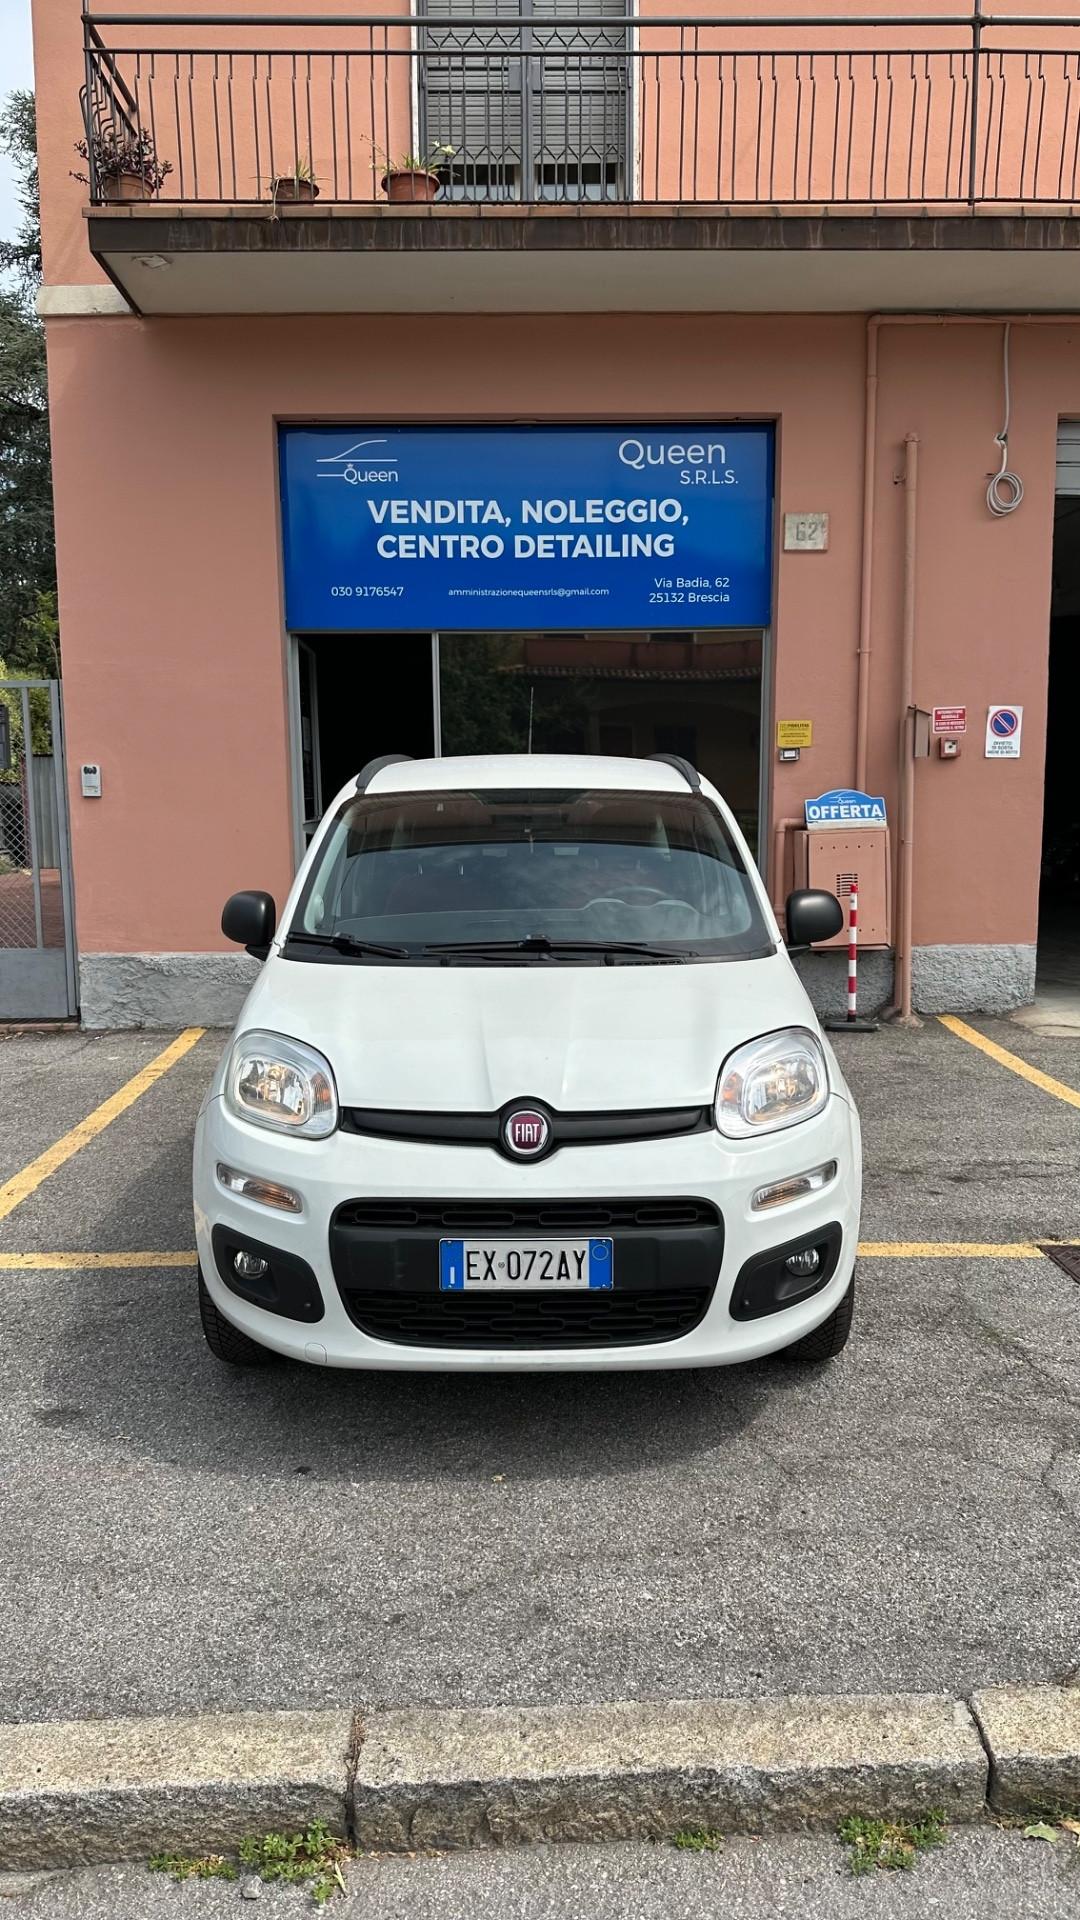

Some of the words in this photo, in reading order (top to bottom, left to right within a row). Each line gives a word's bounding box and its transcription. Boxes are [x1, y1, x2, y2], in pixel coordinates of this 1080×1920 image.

[618, 439, 726, 470] Queen
[344, 468, 398, 485] Queen
[680, 469, 739, 485] S.R.L.S.
[367, 499, 512, 527] VENDITA,
[522, 498, 689, 526] NOLEGGIO,
[376, 534, 505, 559] CENTRO
[514, 533, 675, 558] DETAILING
[654, 577, 673, 588] Via
[676, 577, 712, 589] Badia,
[715, 577, 730, 588] 62
[331, 586, 353, 597] 030
[355, 586, 404, 597] 9176547
[448, 587, 610, 598] amministrazionequeensrls@gmail.com
[649, 592, 686, 603] 25132
[688, 591, 730, 603] Brescia
[808, 804, 883, 819] OFFERTA
[515, 1123, 539, 1142] FIAT
[466, 1250, 497, 1281] EX
[506, 1250, 586, 1281] 072AY
